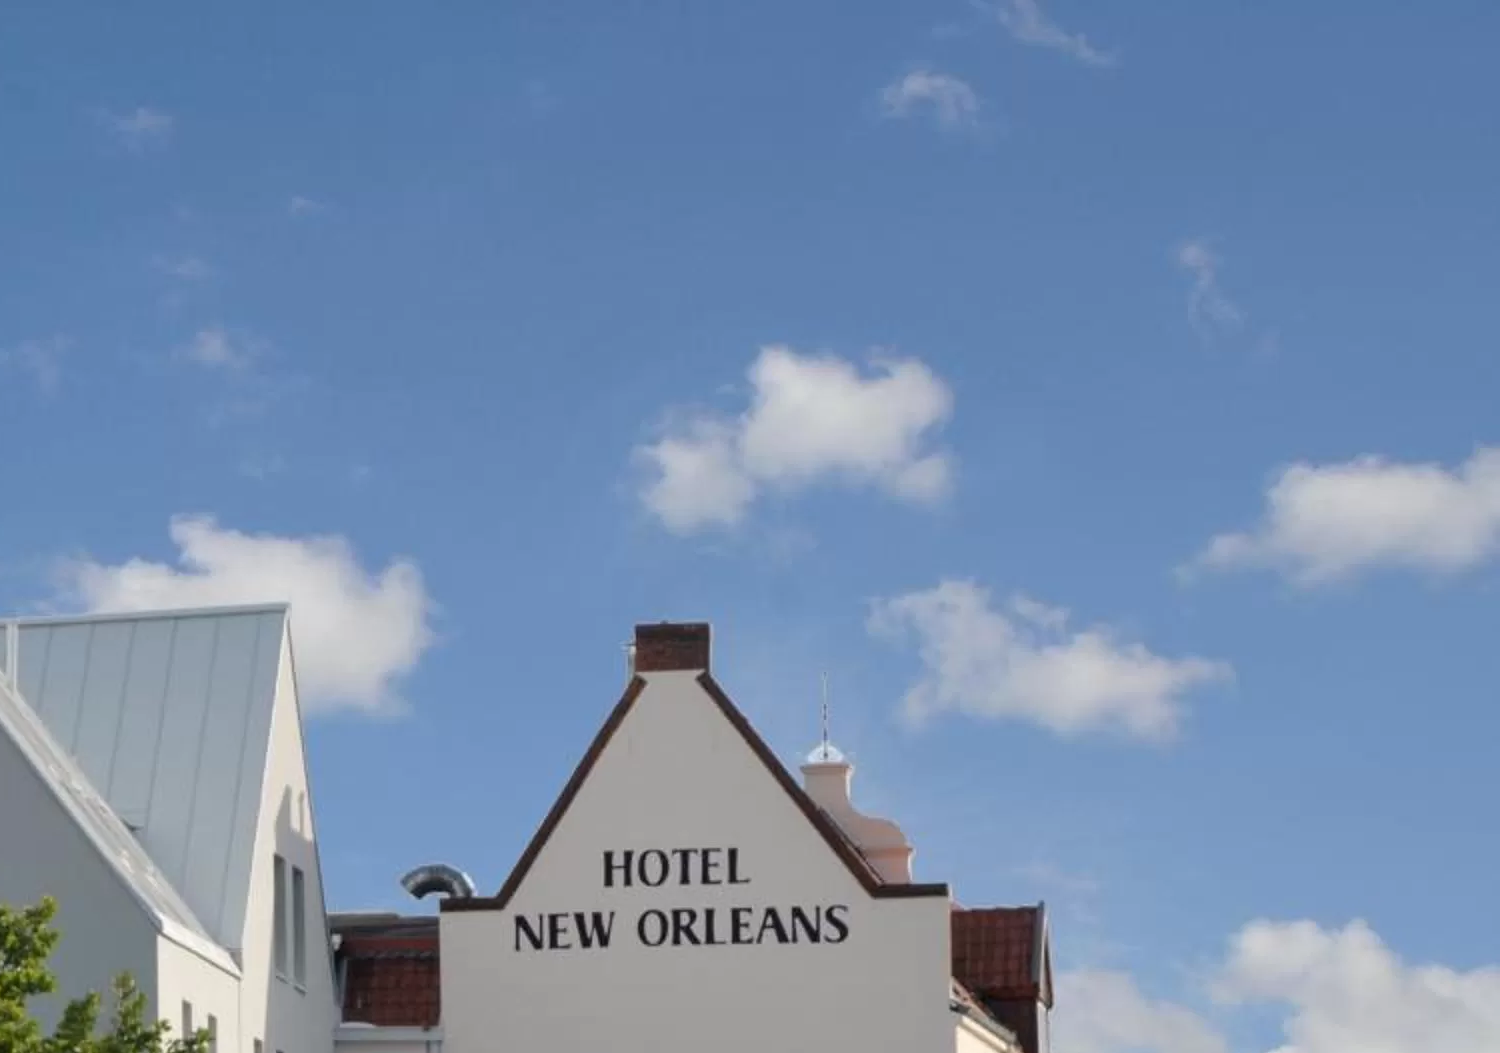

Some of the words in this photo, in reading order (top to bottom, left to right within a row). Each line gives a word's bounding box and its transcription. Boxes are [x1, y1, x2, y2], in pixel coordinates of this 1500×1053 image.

[602, 847, 751, 888] HOTEL
[514, 911, 615, 952] NEW
[637, 904, 849, 947] ORLEANS
